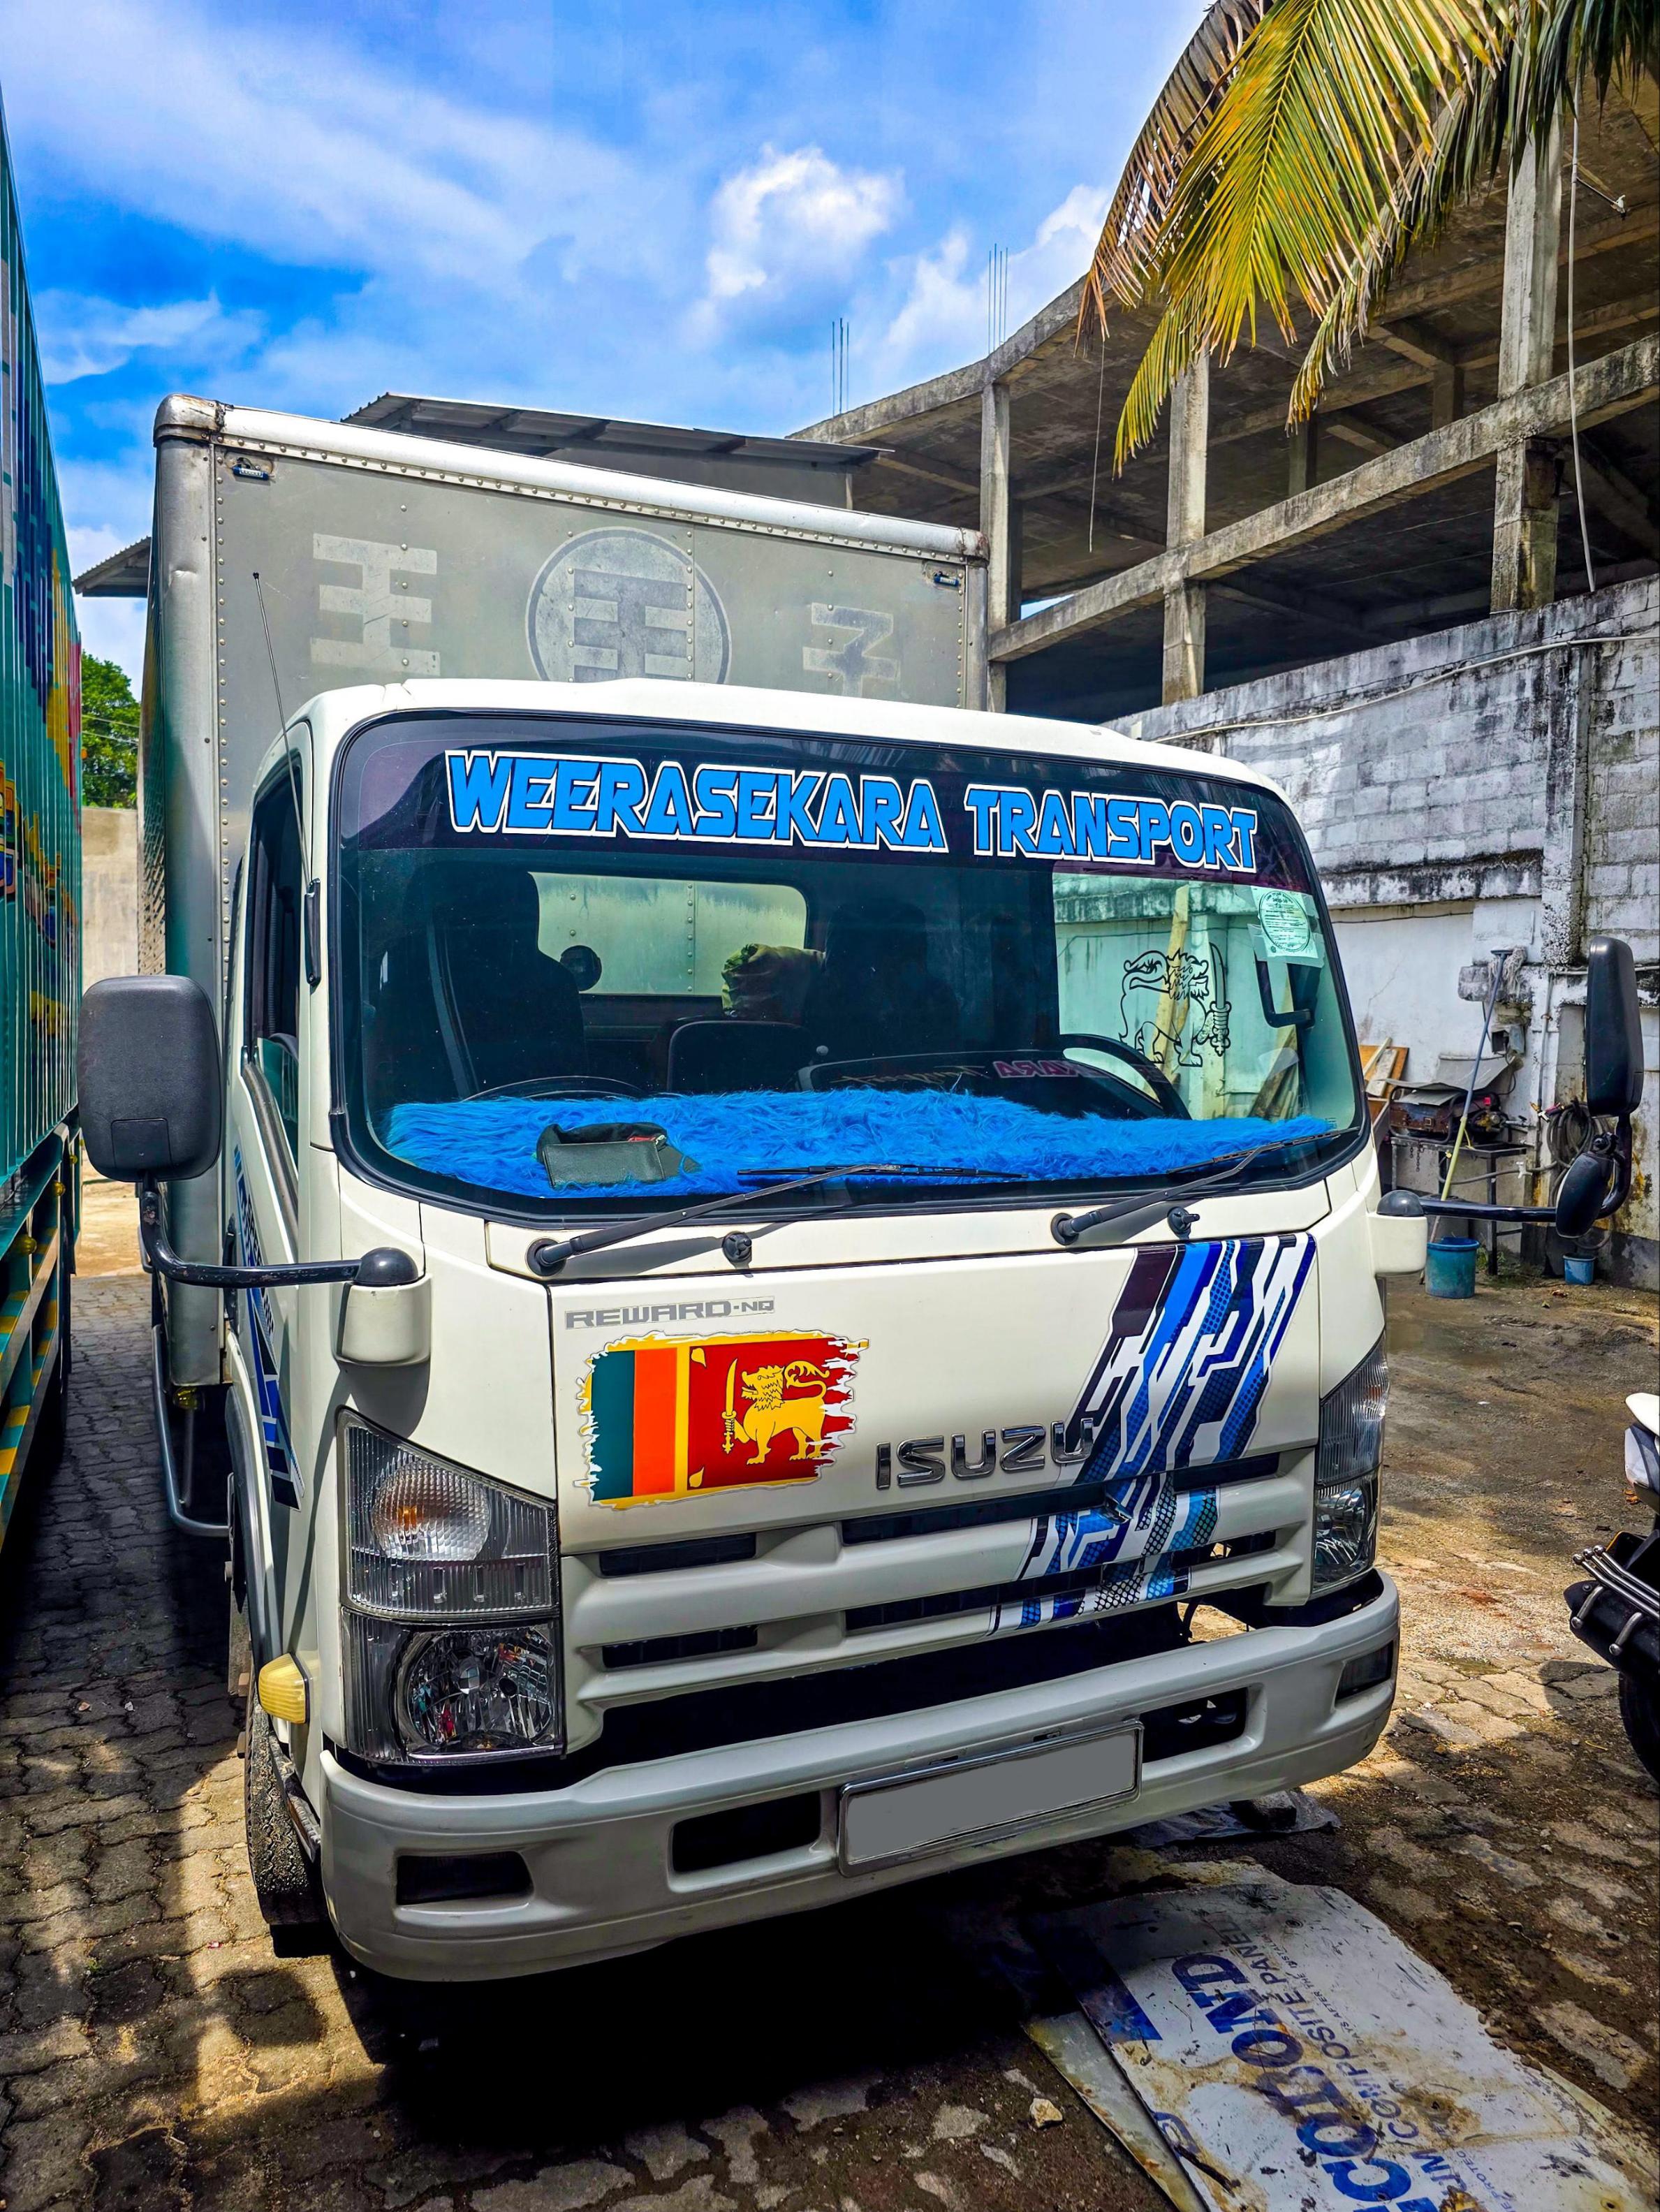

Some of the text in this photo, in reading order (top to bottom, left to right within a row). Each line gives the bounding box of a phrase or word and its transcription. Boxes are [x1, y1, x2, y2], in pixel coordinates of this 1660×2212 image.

[445, 749, 1257, 873] WEERASEKARA TRANSPORT
[876, 1417, 1094, 1490] ISUZU
[1297, 1971, 1315, 1990] THE
[1313, 1991, 1342, 2020] AFTER
[1275, 1989, 1420, 2139] COMPOSITE
